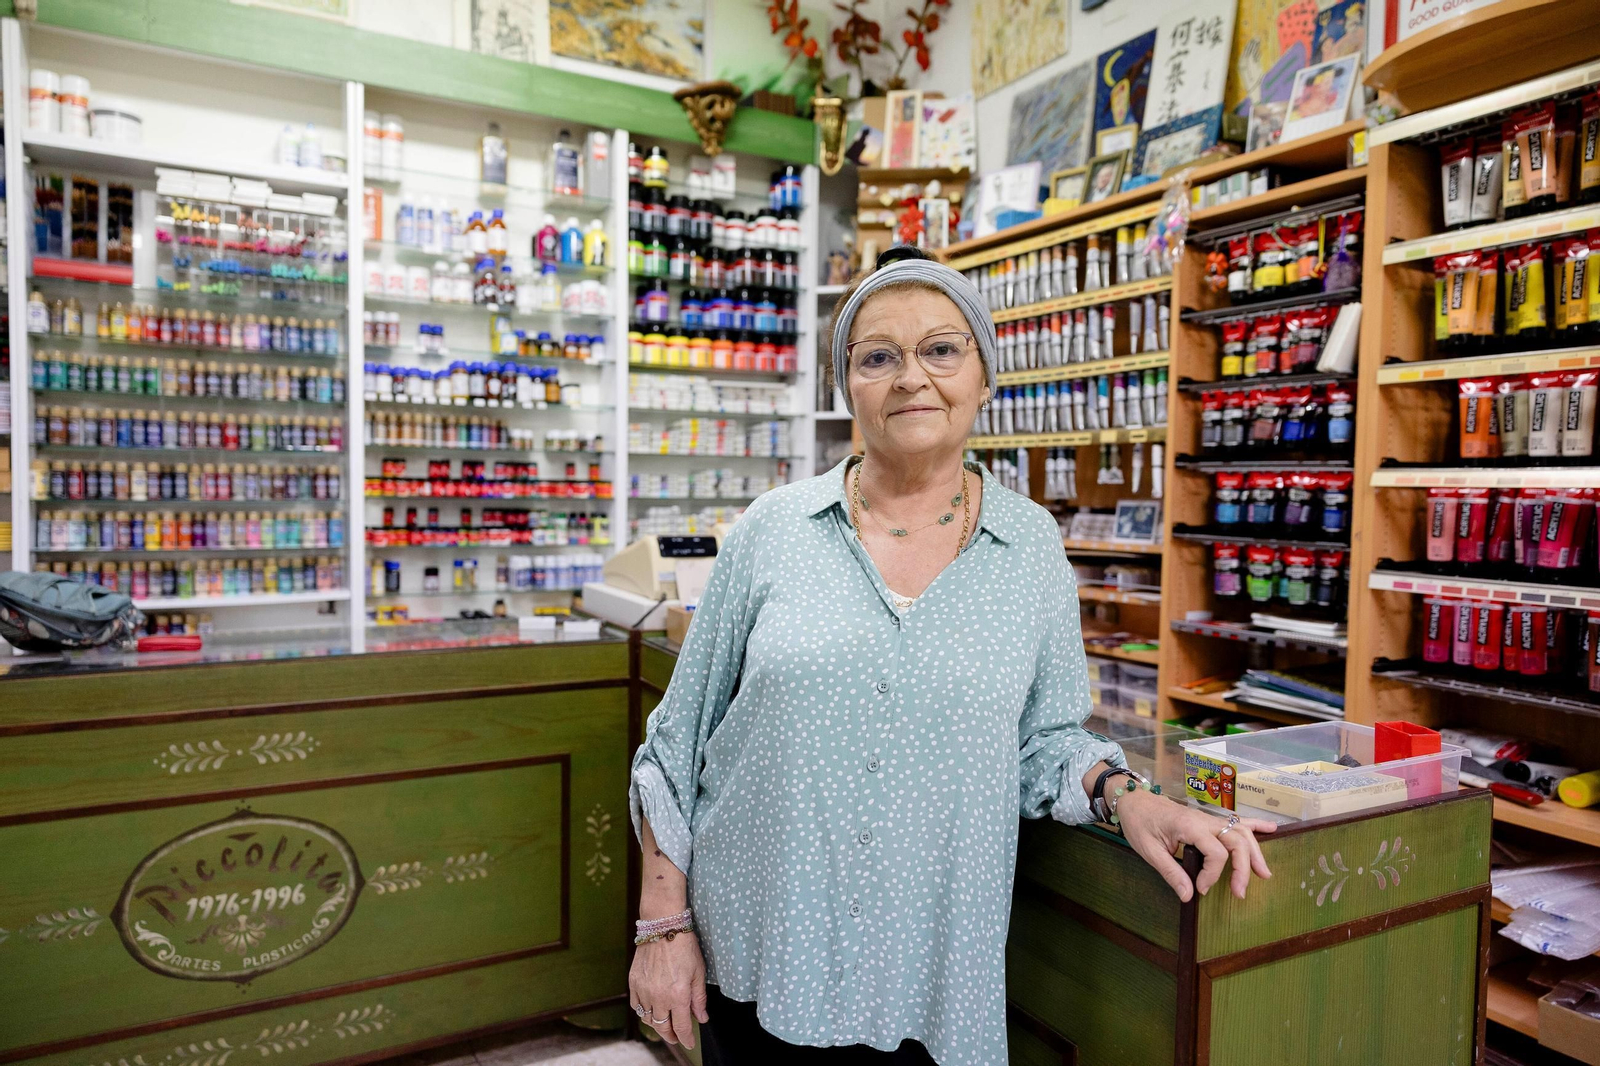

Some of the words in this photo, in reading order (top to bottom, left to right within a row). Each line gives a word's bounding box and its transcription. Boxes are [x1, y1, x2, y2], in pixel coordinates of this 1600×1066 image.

[1408, 7, 1440, 29] GOOD
[1529, 132, 1542, 170] ACRYLIC
[1584, 120, 1598, 161] ACRYLIC
[1452, 273, 1464, 309] ACRYLIC
[1573, 260, 1585, 299] ACRYLIC
[1466, 396, 1478, 433] ACRYLIC
[1532, 393, 1546, 431] ACRYLIC
[1567, 391, 1580, 430] ACRYLIC
[1432, 502, 1445, 537] ACRYLIC
[1460, 502, 1471, 537] ACRYLIC
[1531, 504, 1544, 542] ACRYLIC
[1546, 502, 1564, 541] ACRYLIC
[1428, 603, 1440, 639] ACRYLIC
[1459, 606, 1470, 642] ACRYLIC
[1477, 608, 1489, 645] ACRYLIC
[1522, 611, 1532, 649] ACRYLIC
[1185, 753, 1221, 773] Rellenitos
[1188, 778, 1205, 791] Fini
[186, 882, 306, 922] 1976-1996
[170, 954, 222, 972] ARTES
[243, 928, 322, 968] PLASTICAS
